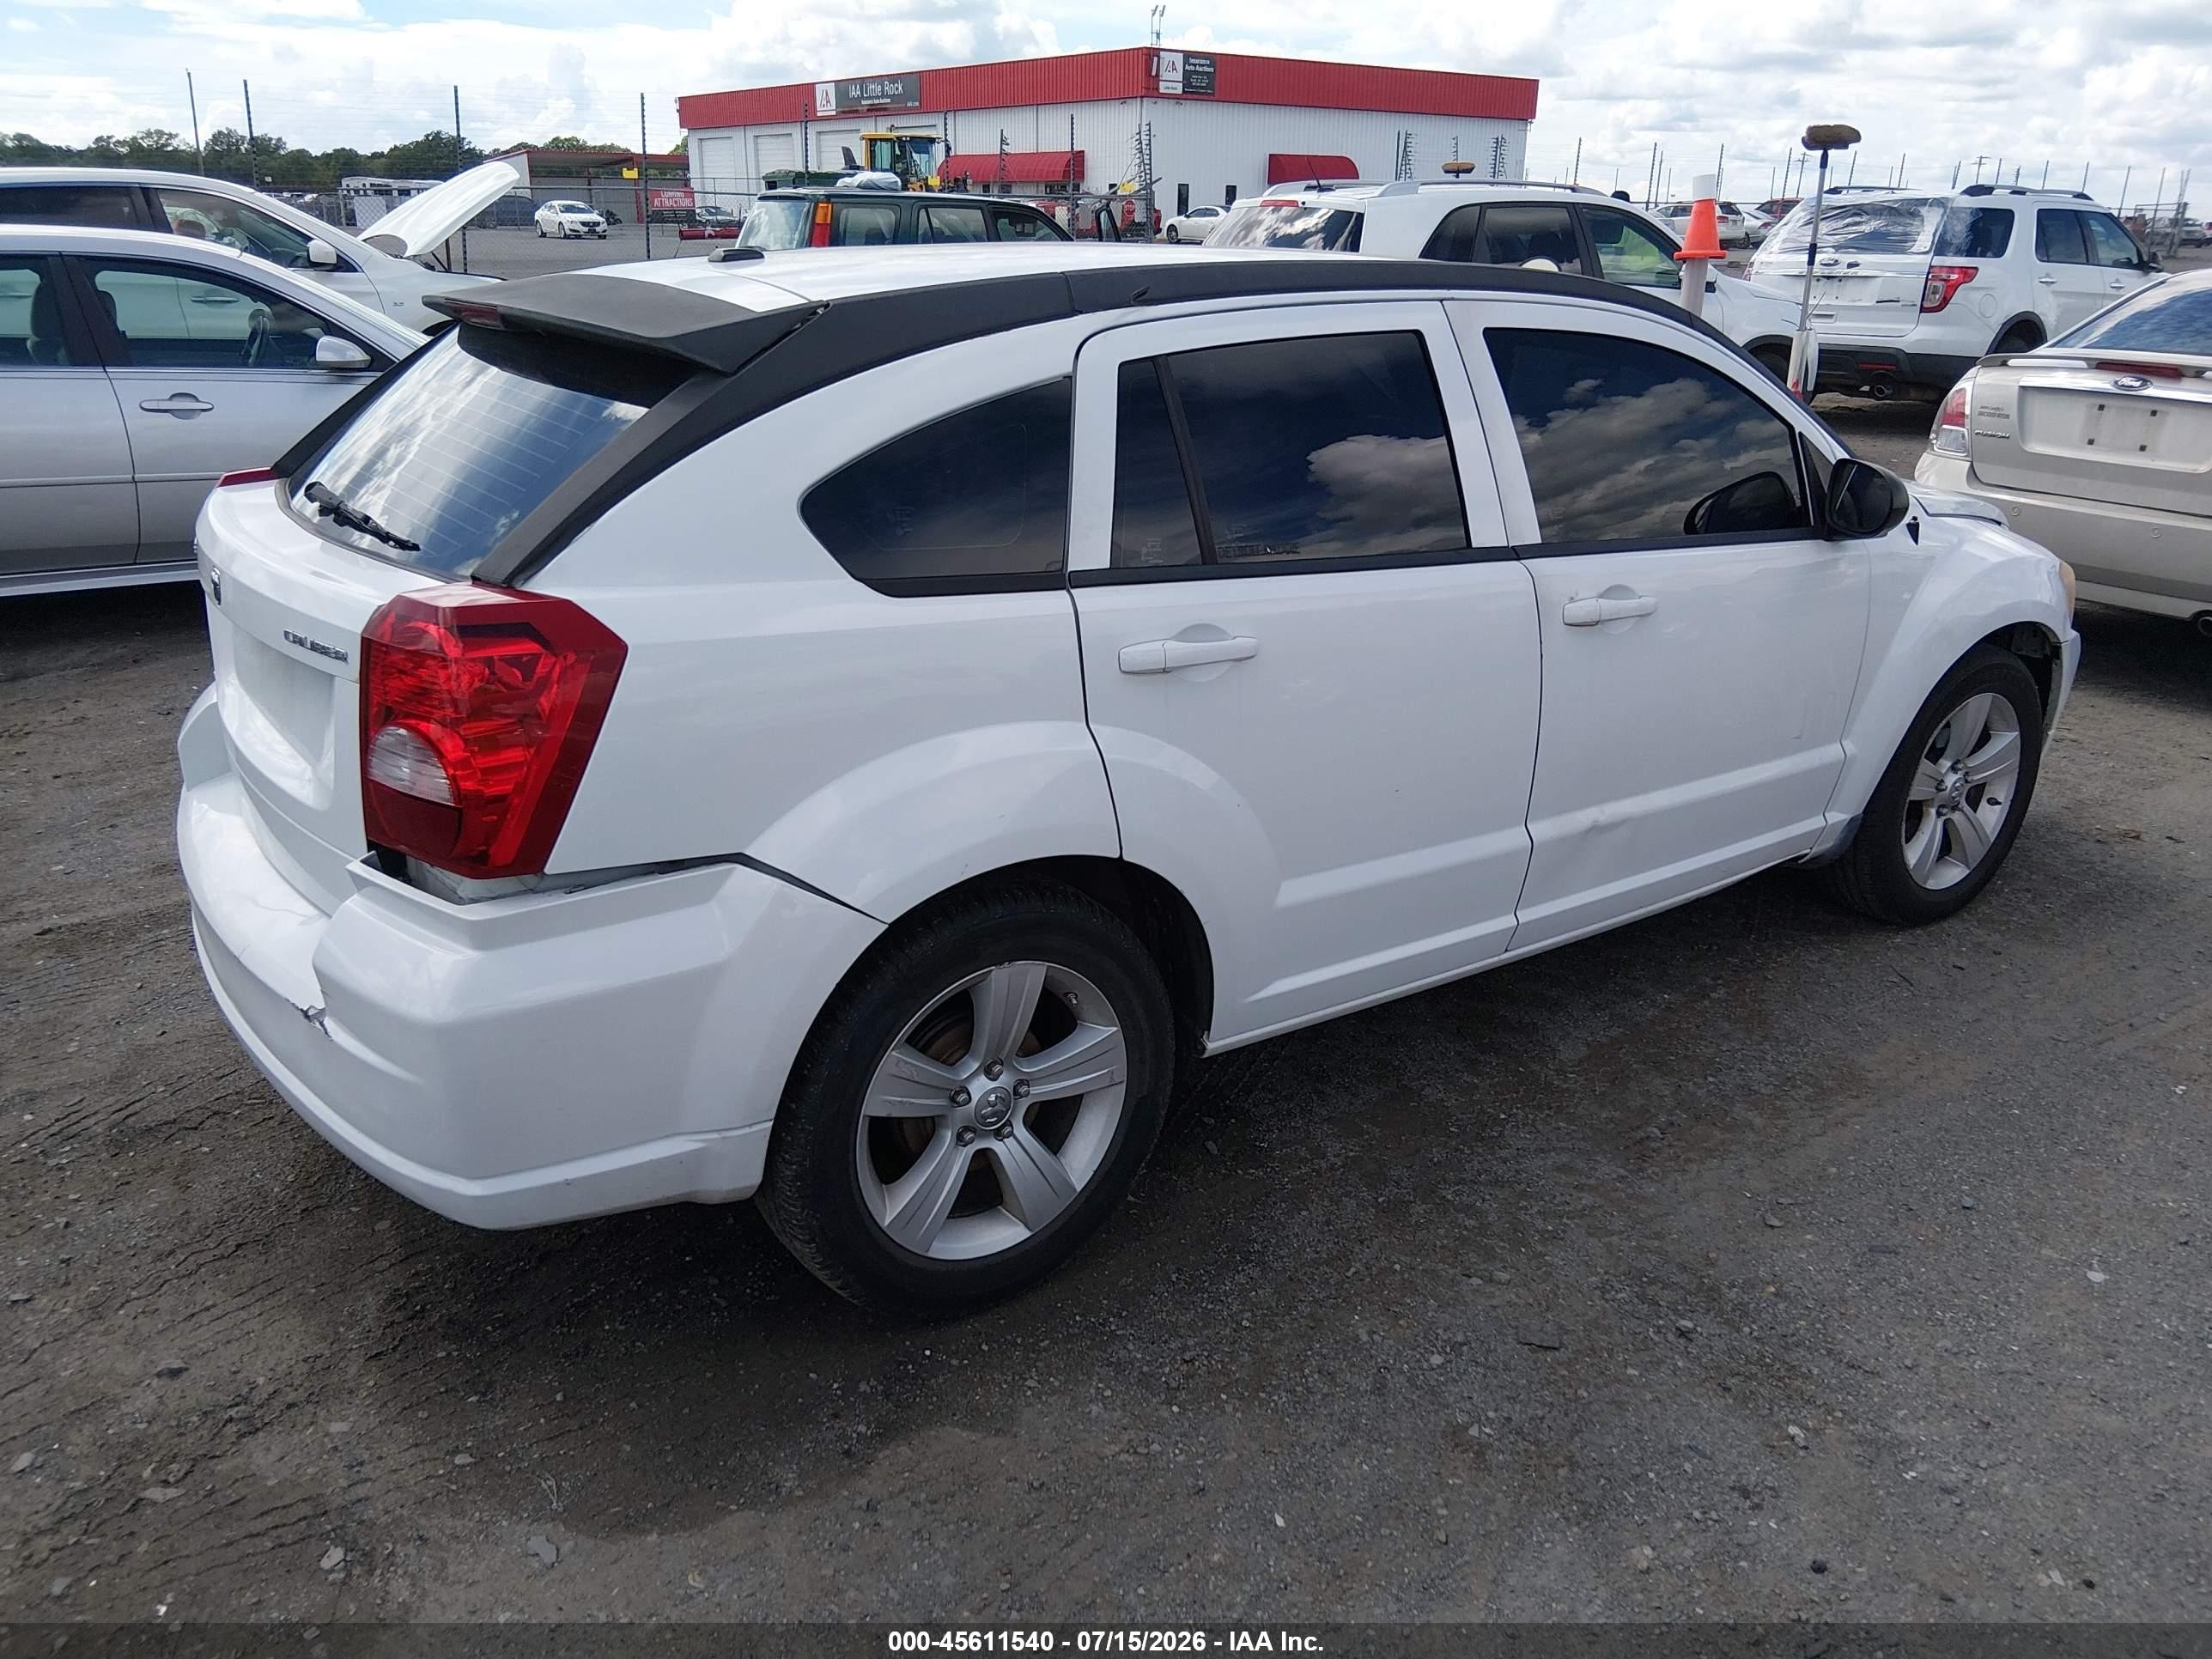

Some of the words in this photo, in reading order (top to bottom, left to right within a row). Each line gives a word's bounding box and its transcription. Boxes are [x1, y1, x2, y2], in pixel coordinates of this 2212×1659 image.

[848, 84, 861, 99] IAA
[863, 82, 882, 97] Little
[884, 79, 904, 96] Rock
[653, 198, 694, 207] ATTRACTIONS
[2118, 377, 2144, 387] Ford
